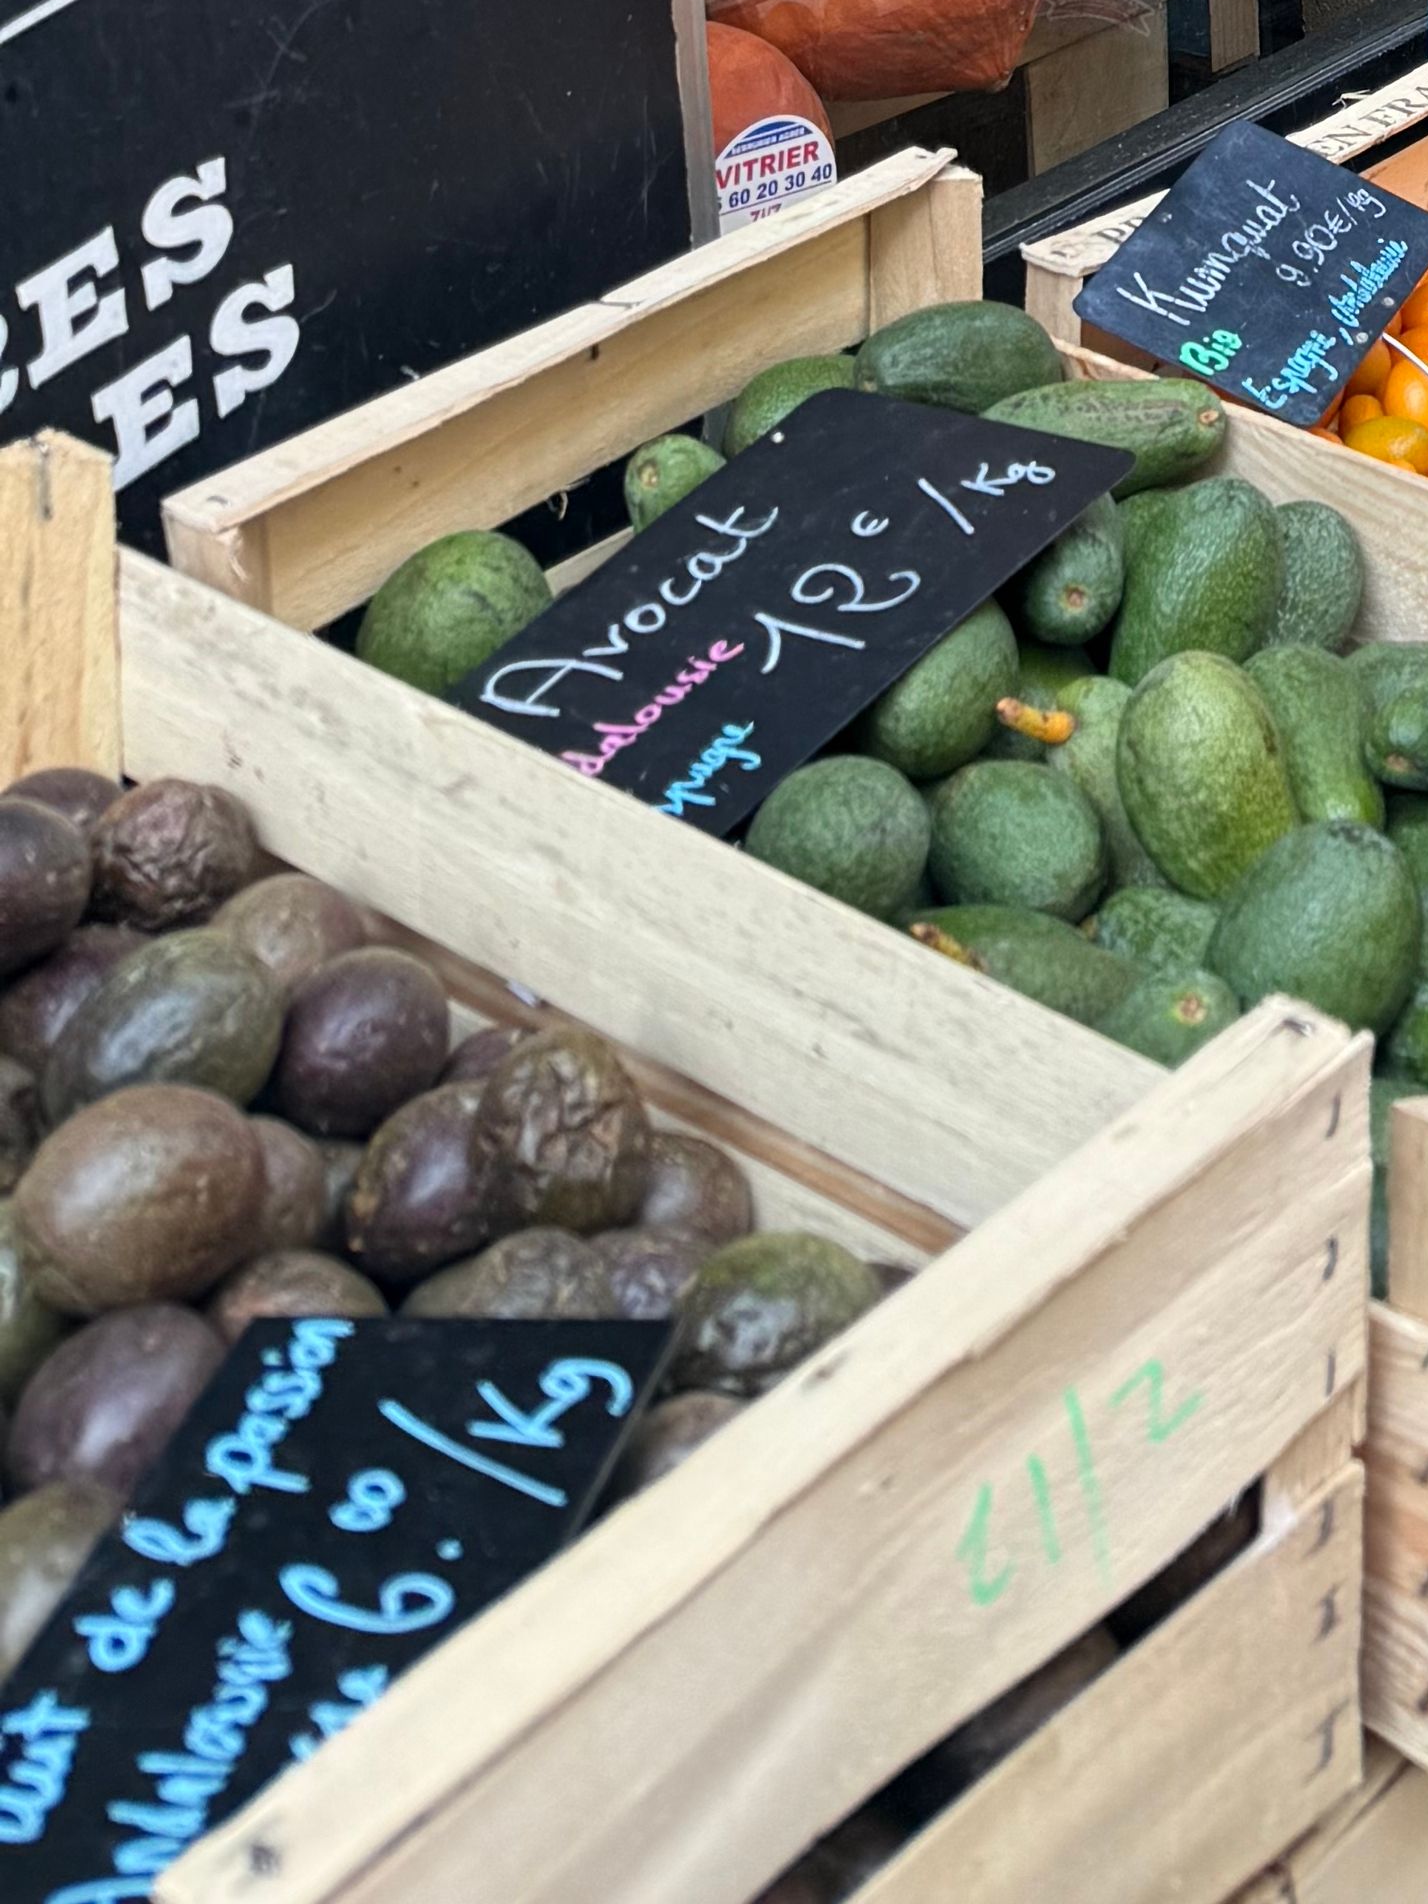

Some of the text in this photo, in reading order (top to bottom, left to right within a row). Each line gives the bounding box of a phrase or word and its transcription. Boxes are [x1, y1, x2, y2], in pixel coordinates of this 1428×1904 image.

[715, 140, 821, 191] VITRIER
[728, 162, 833, 209] 60 20 30 40
[90, 262, 300, 493] ES
[1178, 328, 1243, 377] Bio
[480, 504, 780, 720] Avocat
[560, 639, 746, 778] dalousie
[205, 1317, 356, 1496] passion
[123, 1496, 236, 1566] la
[73, 1578, 176, 1674] de
[44, 1609, 296, 1904] ndalousie
